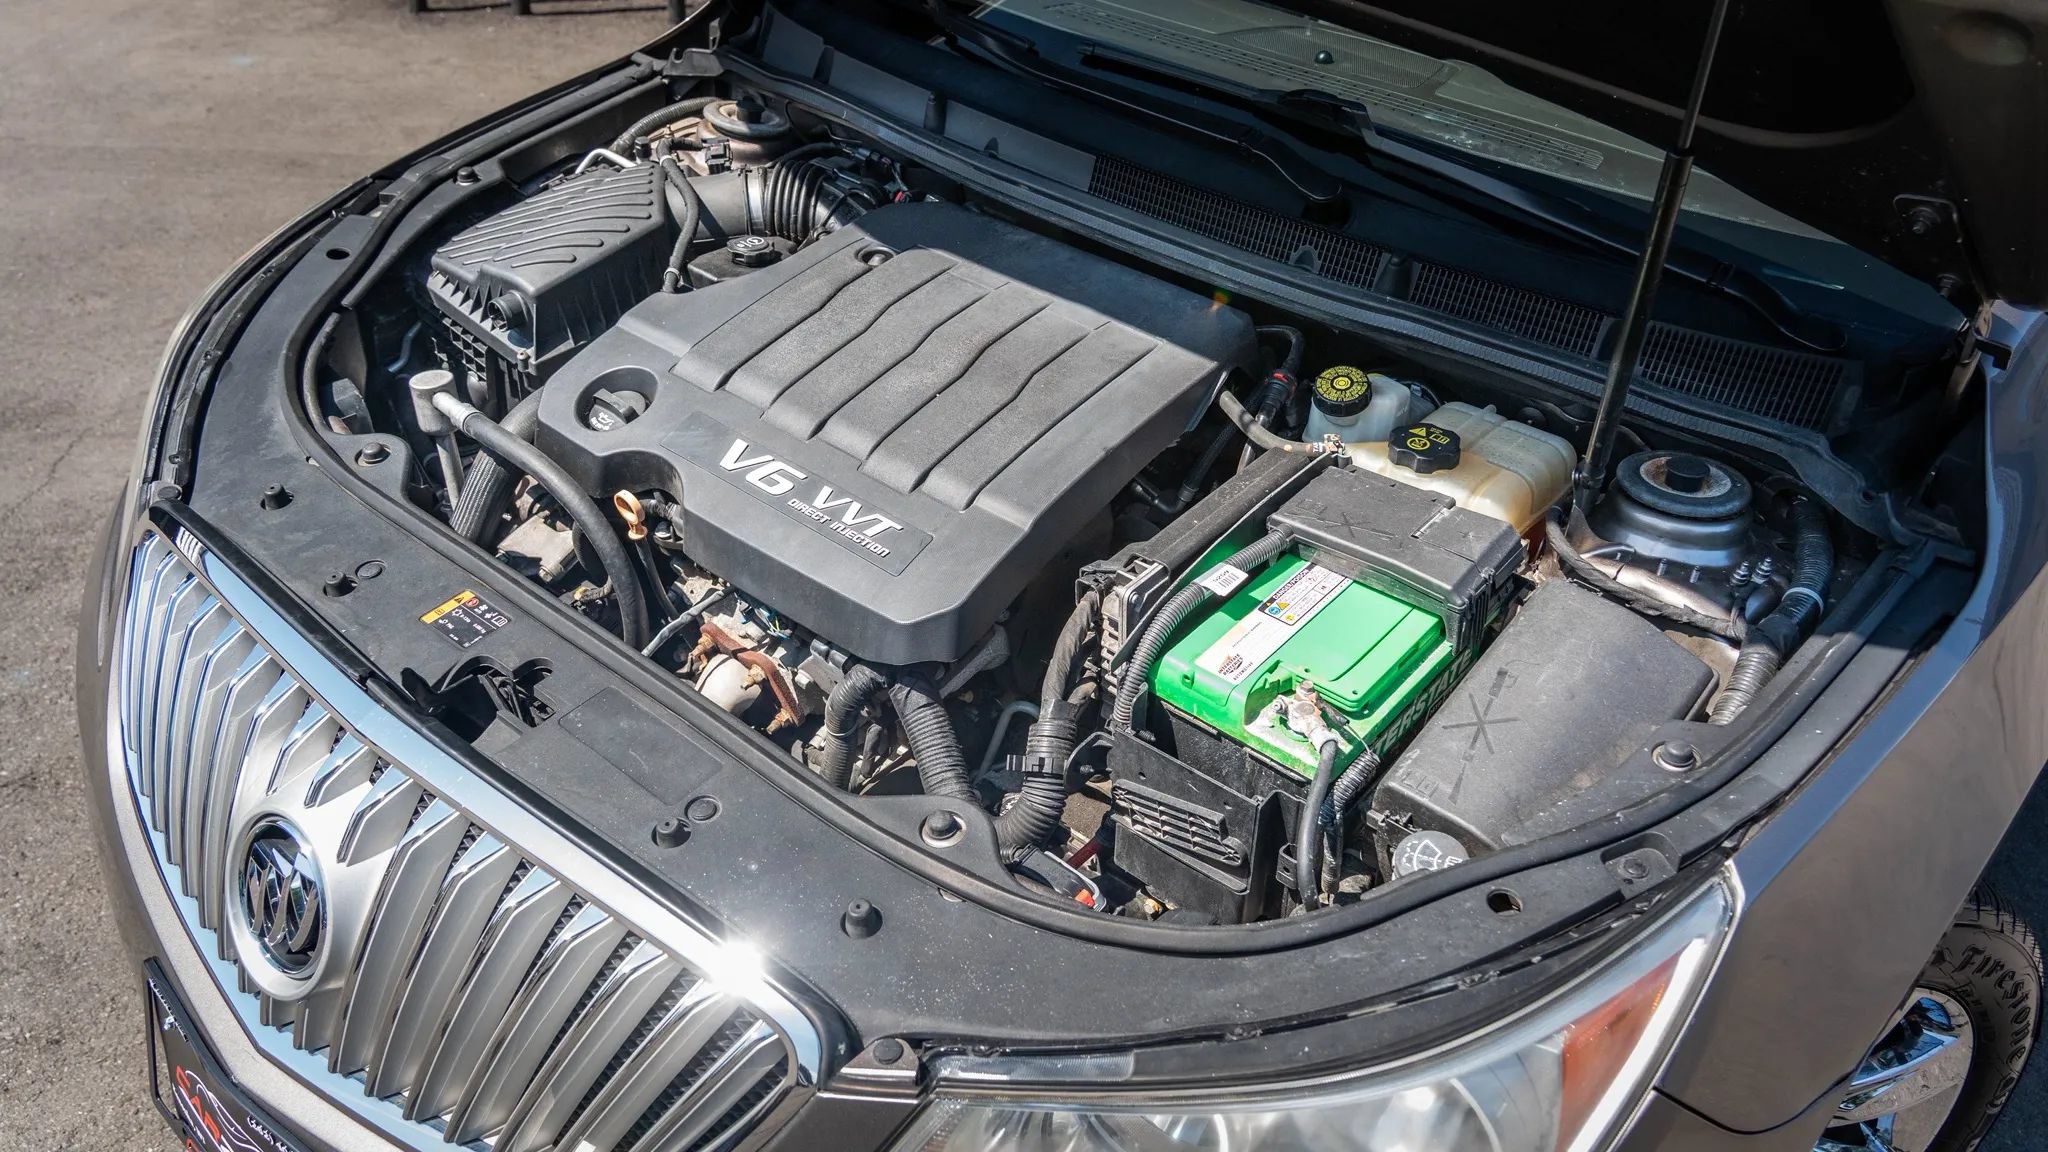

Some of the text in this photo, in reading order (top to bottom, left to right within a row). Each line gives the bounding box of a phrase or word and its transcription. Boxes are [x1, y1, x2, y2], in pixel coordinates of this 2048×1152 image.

[719, 438, 904, 539] V6 VVT
[787, 497, 891, 558] DIRECT INJECTION
[1374, 648, 1473, 757] TERSTATE
[1952, 943, 2033, 1070] Firestone
